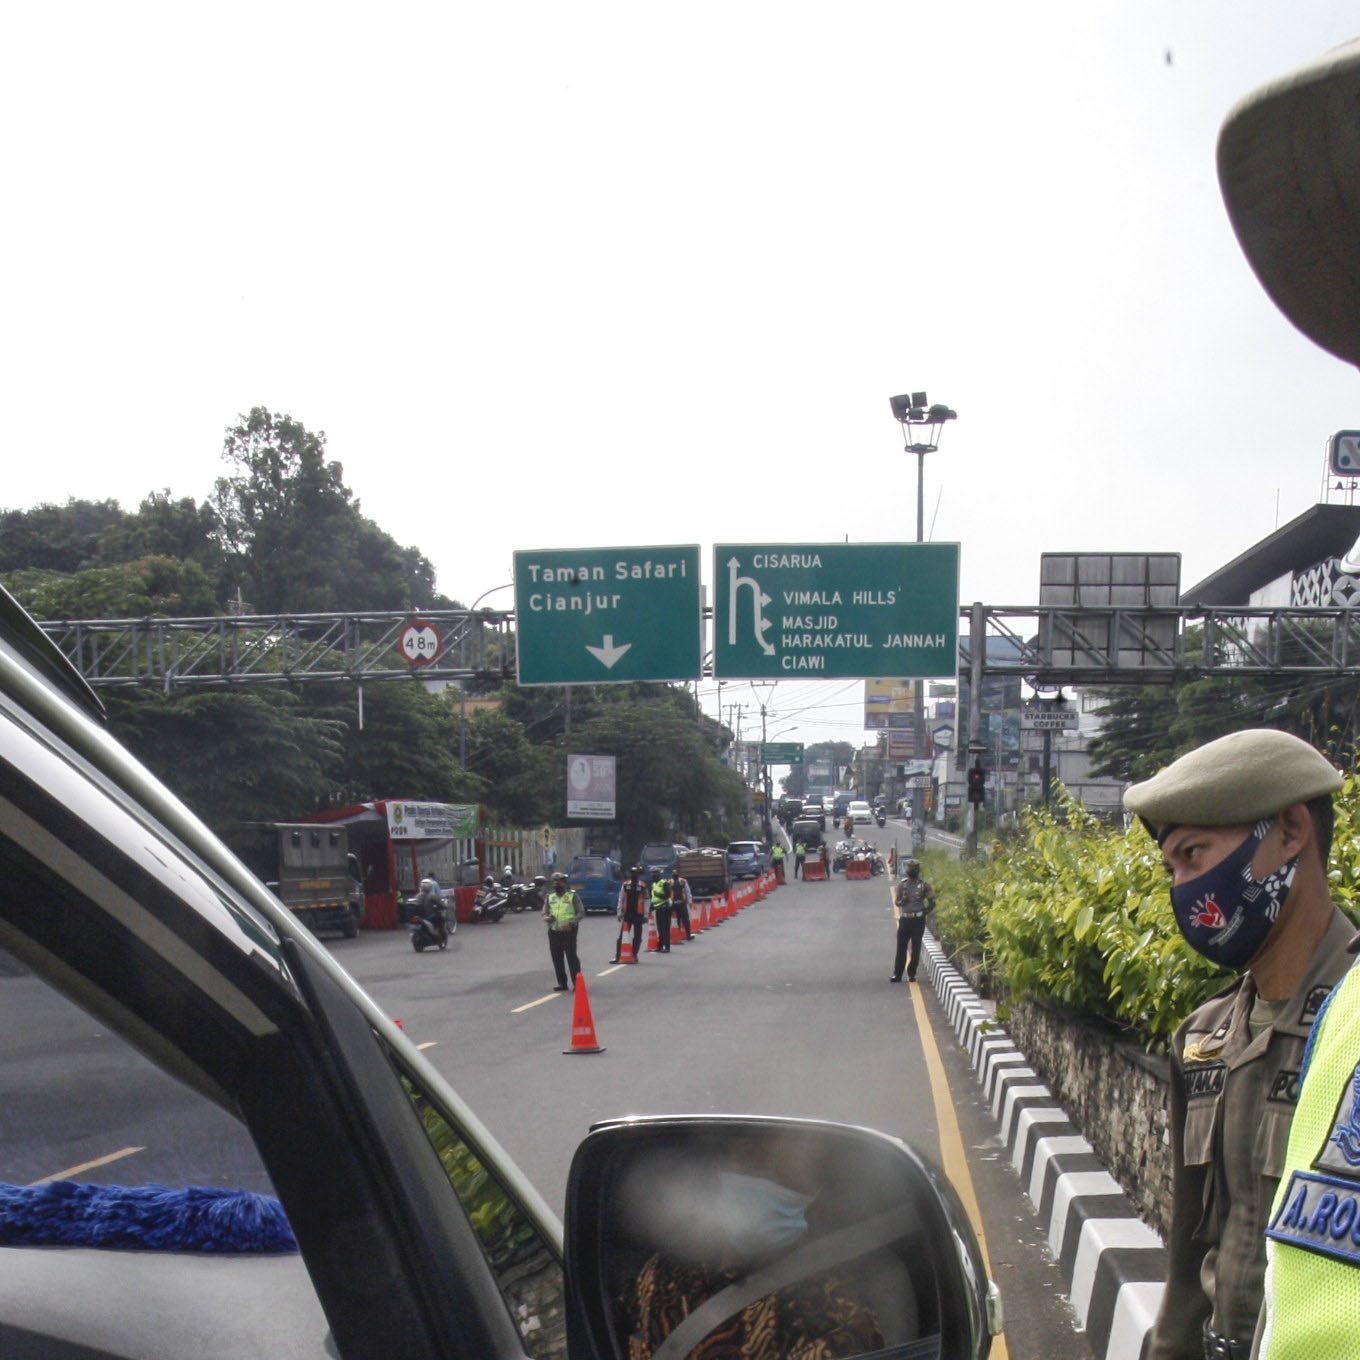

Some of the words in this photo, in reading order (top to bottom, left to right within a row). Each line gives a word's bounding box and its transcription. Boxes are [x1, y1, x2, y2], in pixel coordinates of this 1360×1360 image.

[753, 554, 822, 568] CISARUA
[528, 565, 605, 582] Taman
[615, 560, 686, 580] Safari
[529, 592, 621, 615] Cianjur
[783, 591, 842, 605] VIMALA
[853, 591, 896, 605] HILLS
[782, 616, 838, 630] MASJID
[782, 634, 873, 648] HARAKATUL
[883, 634, 946, 648] JANNAH
[782, 655, 825, 670] CIAWI
